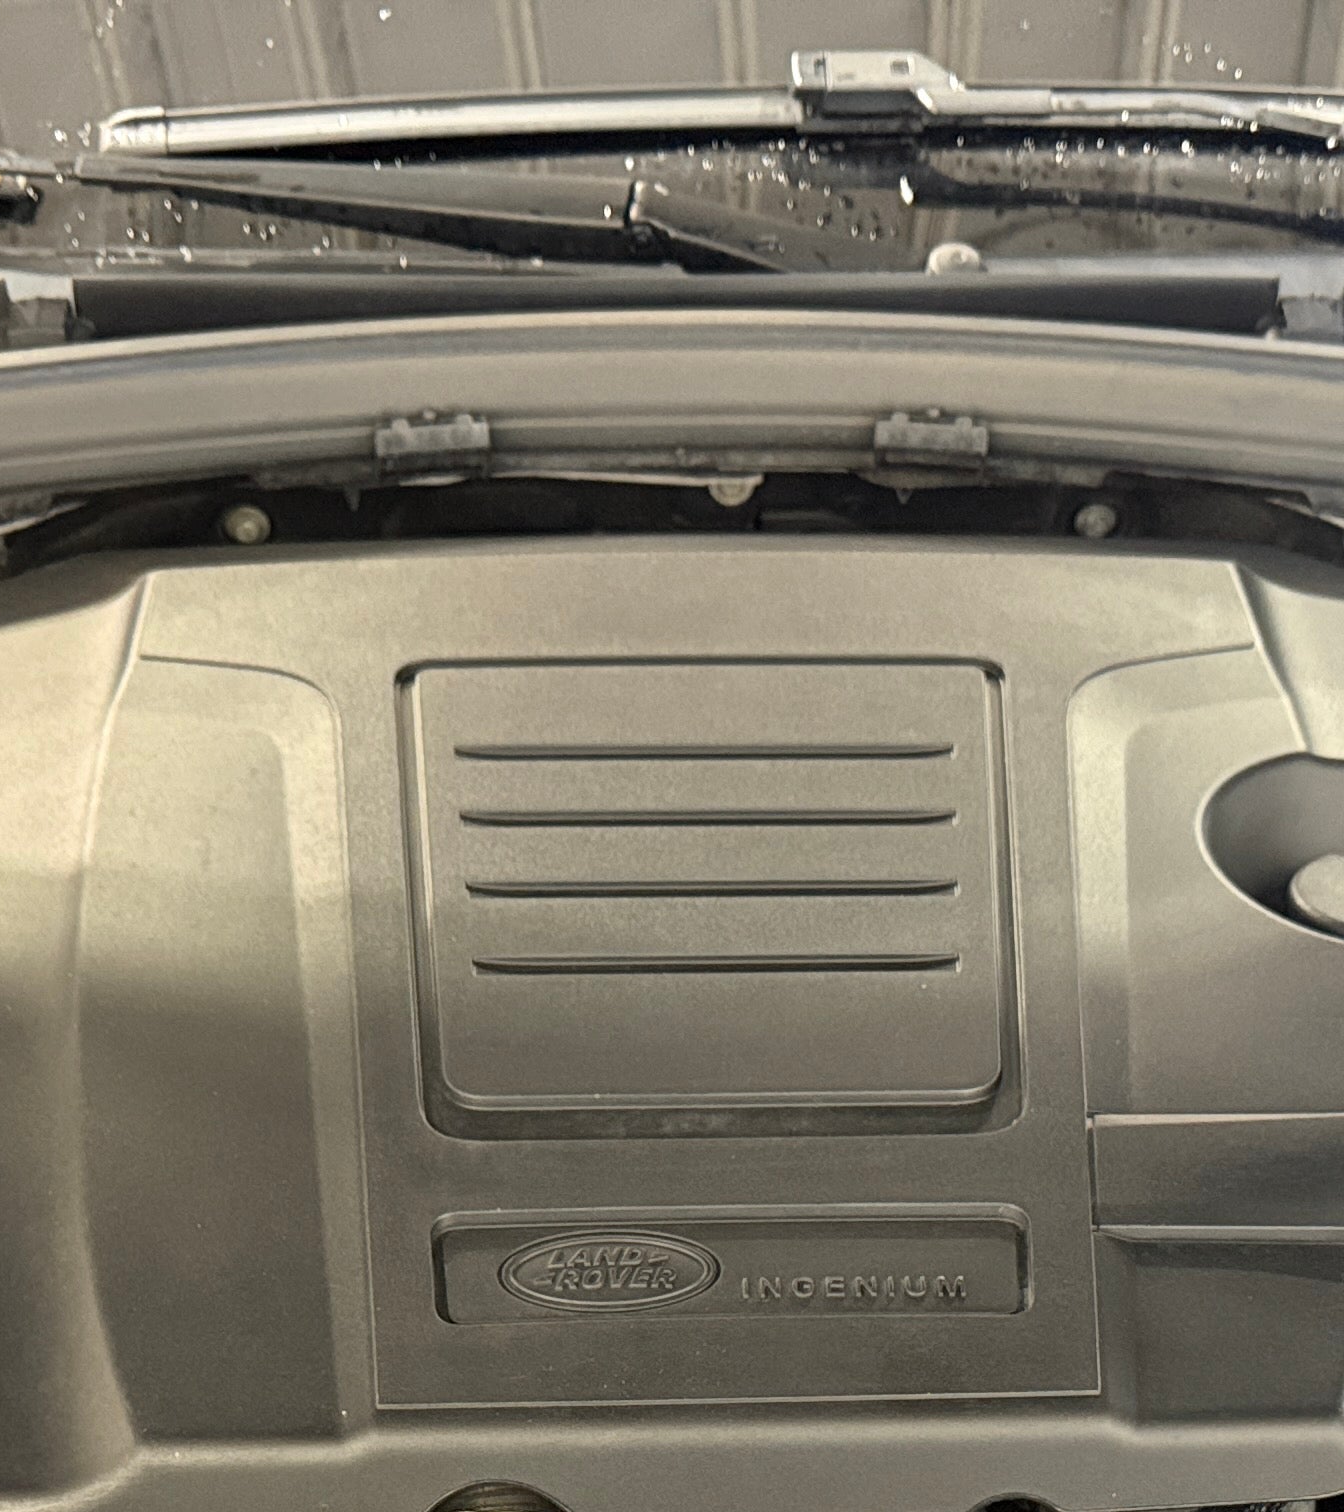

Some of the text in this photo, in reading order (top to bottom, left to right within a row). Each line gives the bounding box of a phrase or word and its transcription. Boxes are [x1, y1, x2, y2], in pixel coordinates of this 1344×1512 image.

[546, 1245, 643, 1269] LAND
[554, 1266, 676, 1291] ROVER
[741, 1275, 968, 1299] INGENIUM
